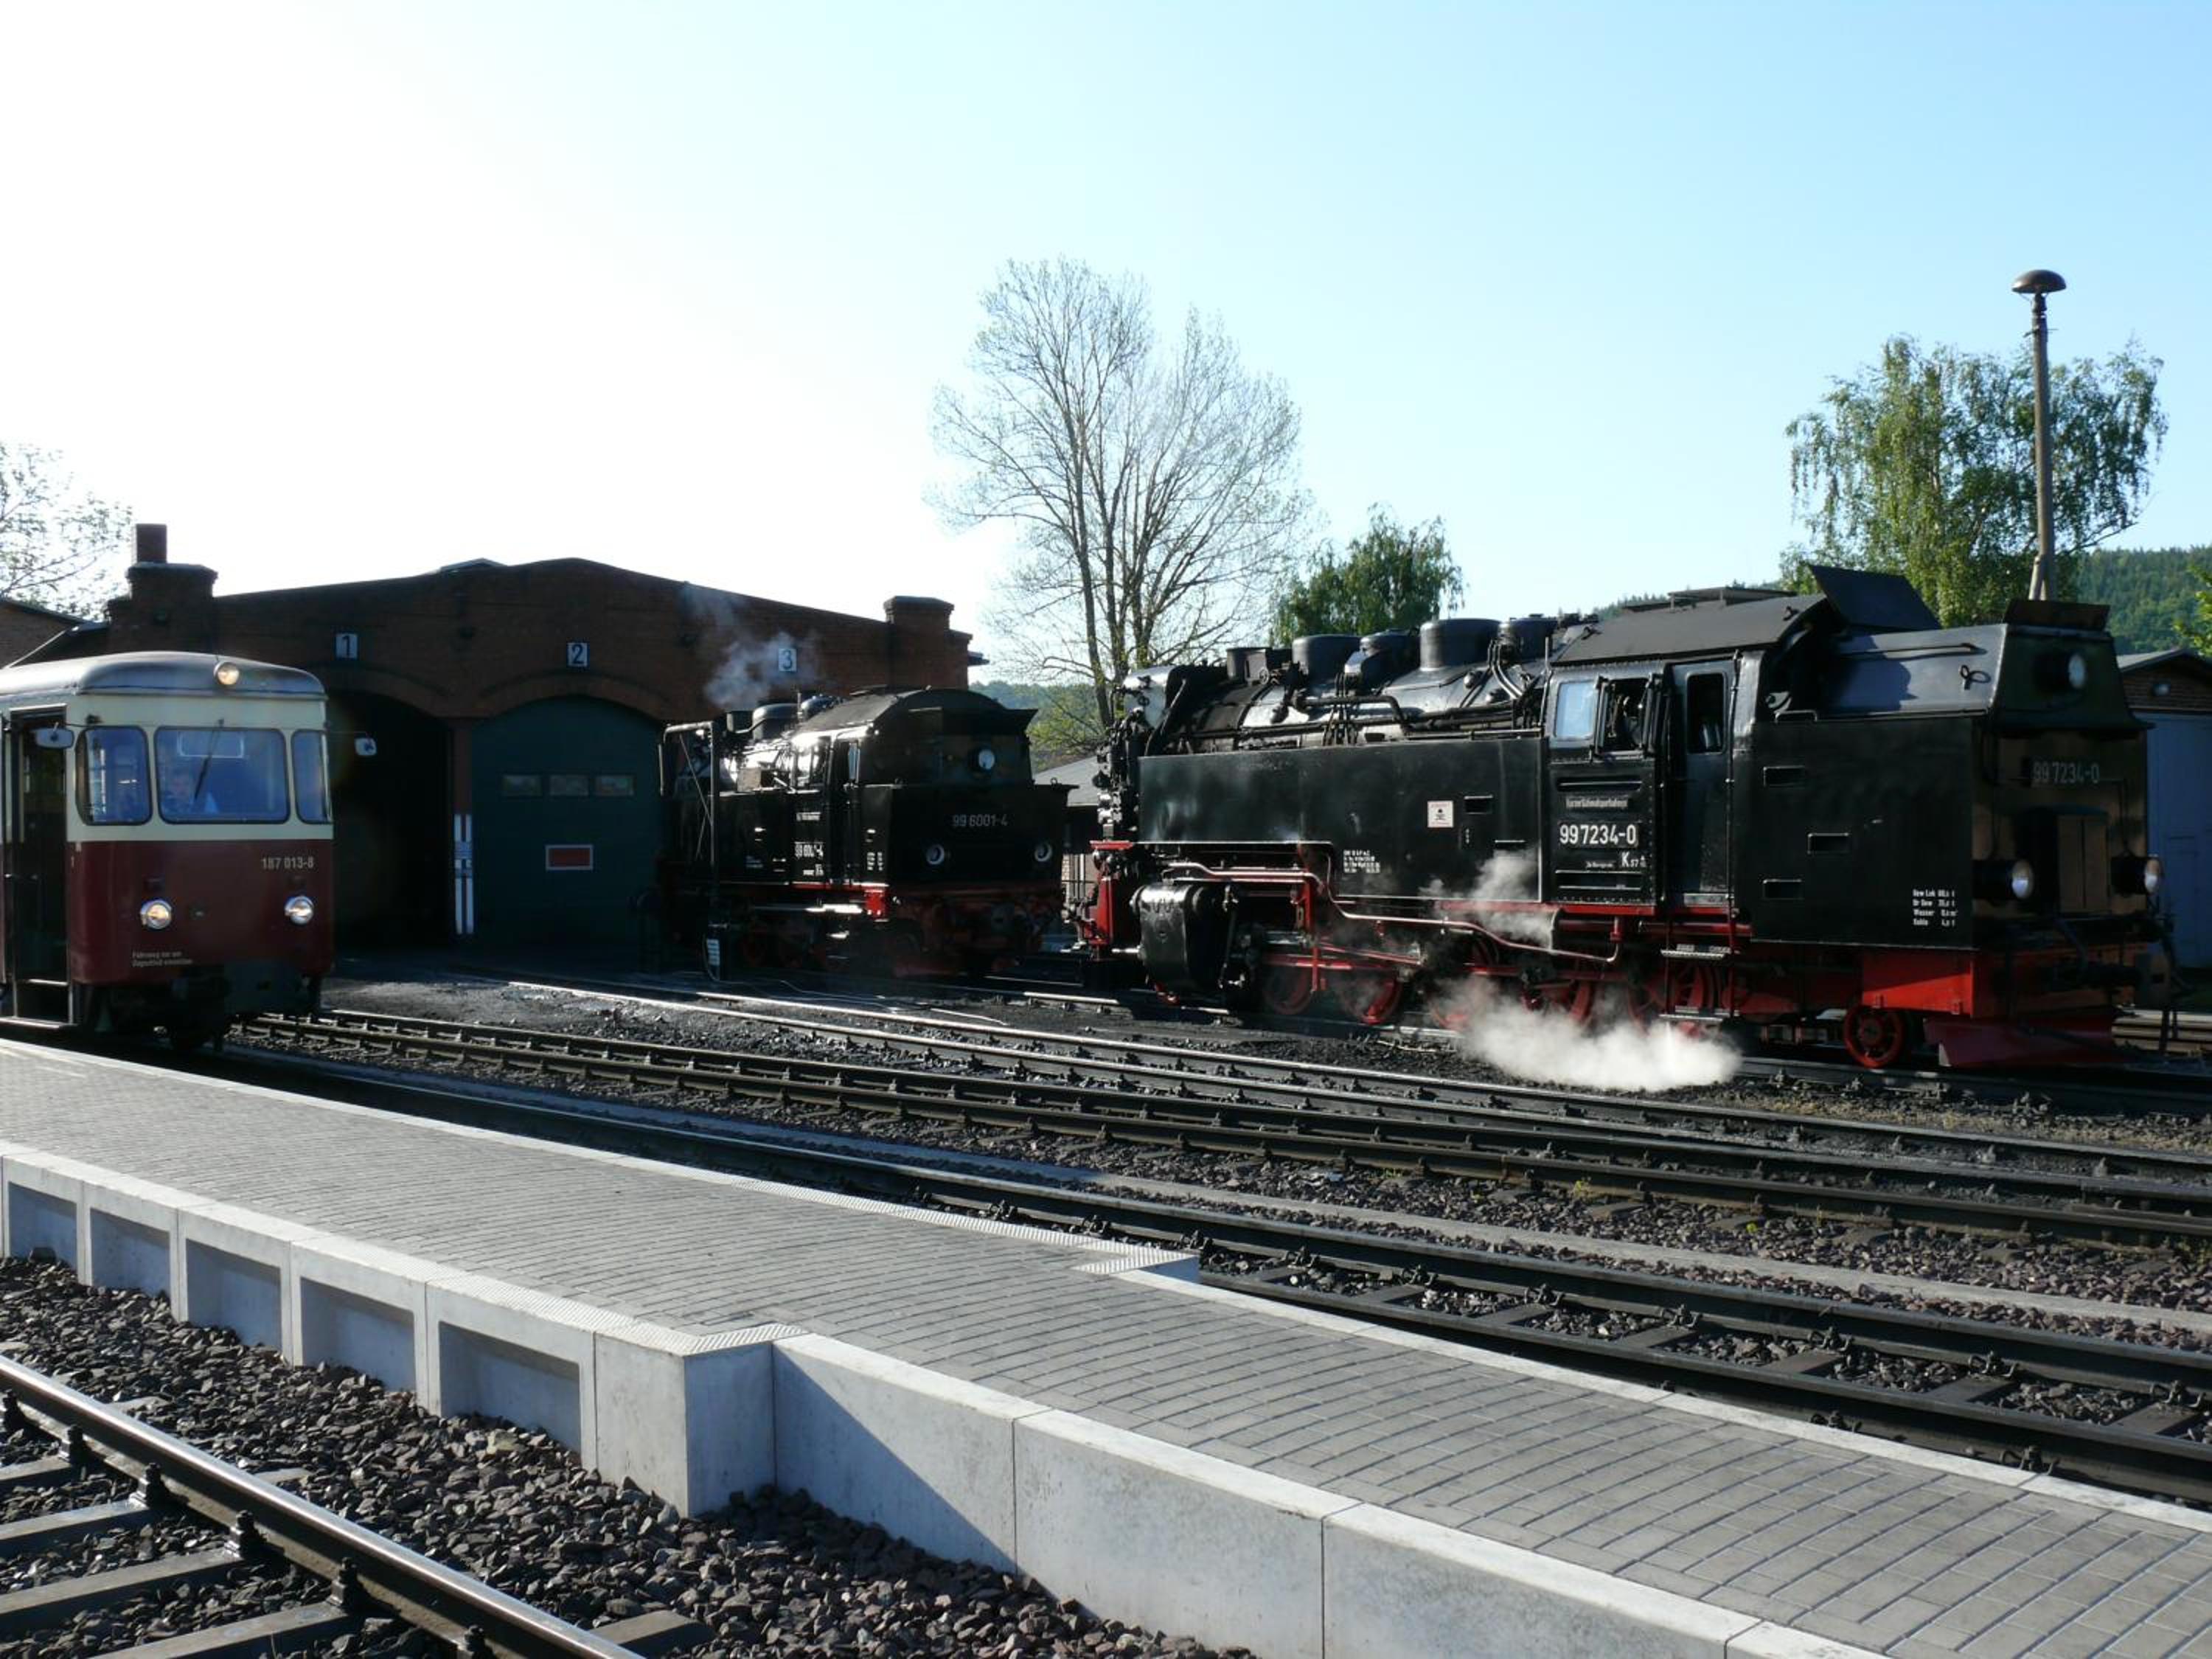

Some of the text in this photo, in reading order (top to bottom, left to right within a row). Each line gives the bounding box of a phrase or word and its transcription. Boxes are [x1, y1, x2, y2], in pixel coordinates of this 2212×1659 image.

[342, 636, 349, 655] 1
[571, 644, 585, 664] 2
[782, 650, 793, 670] 3
[2033, 760, 2100, 784] 99 7234-0
[952, 813, 1008, 827] 99 6001-4
[1559, 824, 1637, 845] 99 7234-0
[260, 856, 313, 869] 187 013-8
[1621, 851, 1630, 867] K
